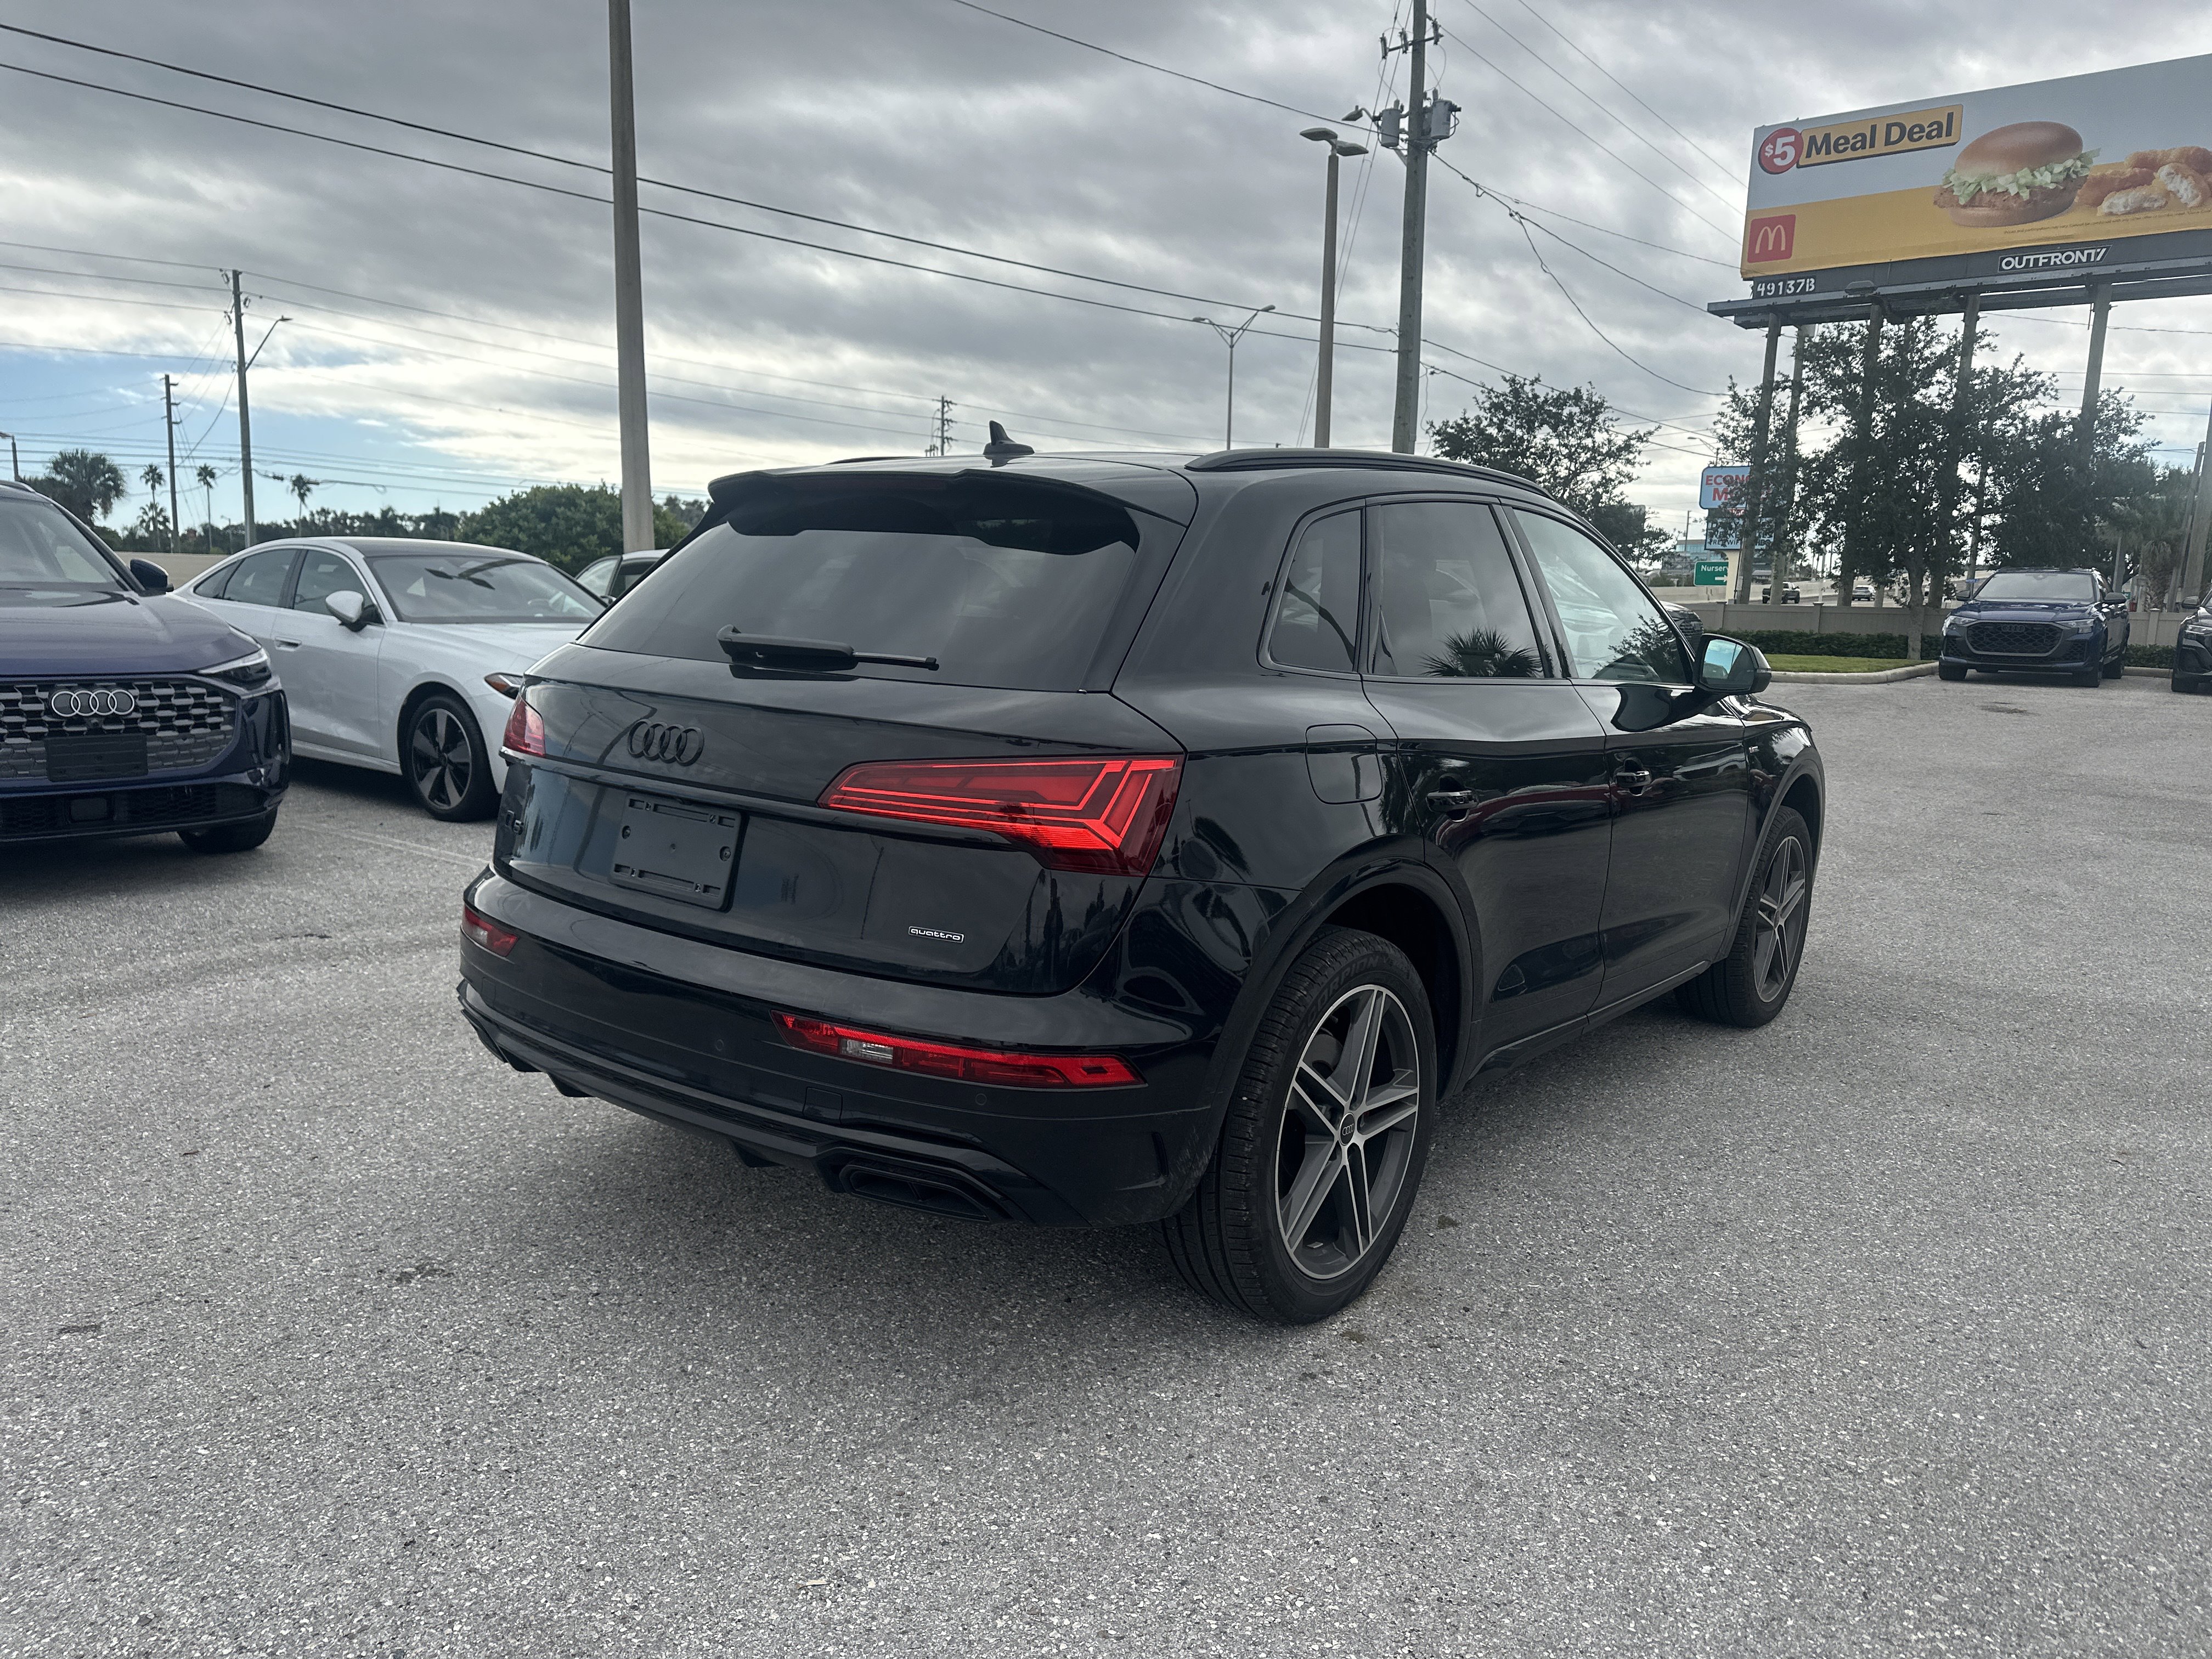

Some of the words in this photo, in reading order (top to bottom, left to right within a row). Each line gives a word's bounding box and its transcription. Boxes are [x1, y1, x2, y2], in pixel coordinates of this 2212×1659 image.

[1764, 135, 1796, 166] $5
[1805, 123, 1877, 159] Meal
[1883, 111, 1955, 147] Deal
[1757, 278, 1815, 297] 49137B
[910, 928, 961, 941] quattro
